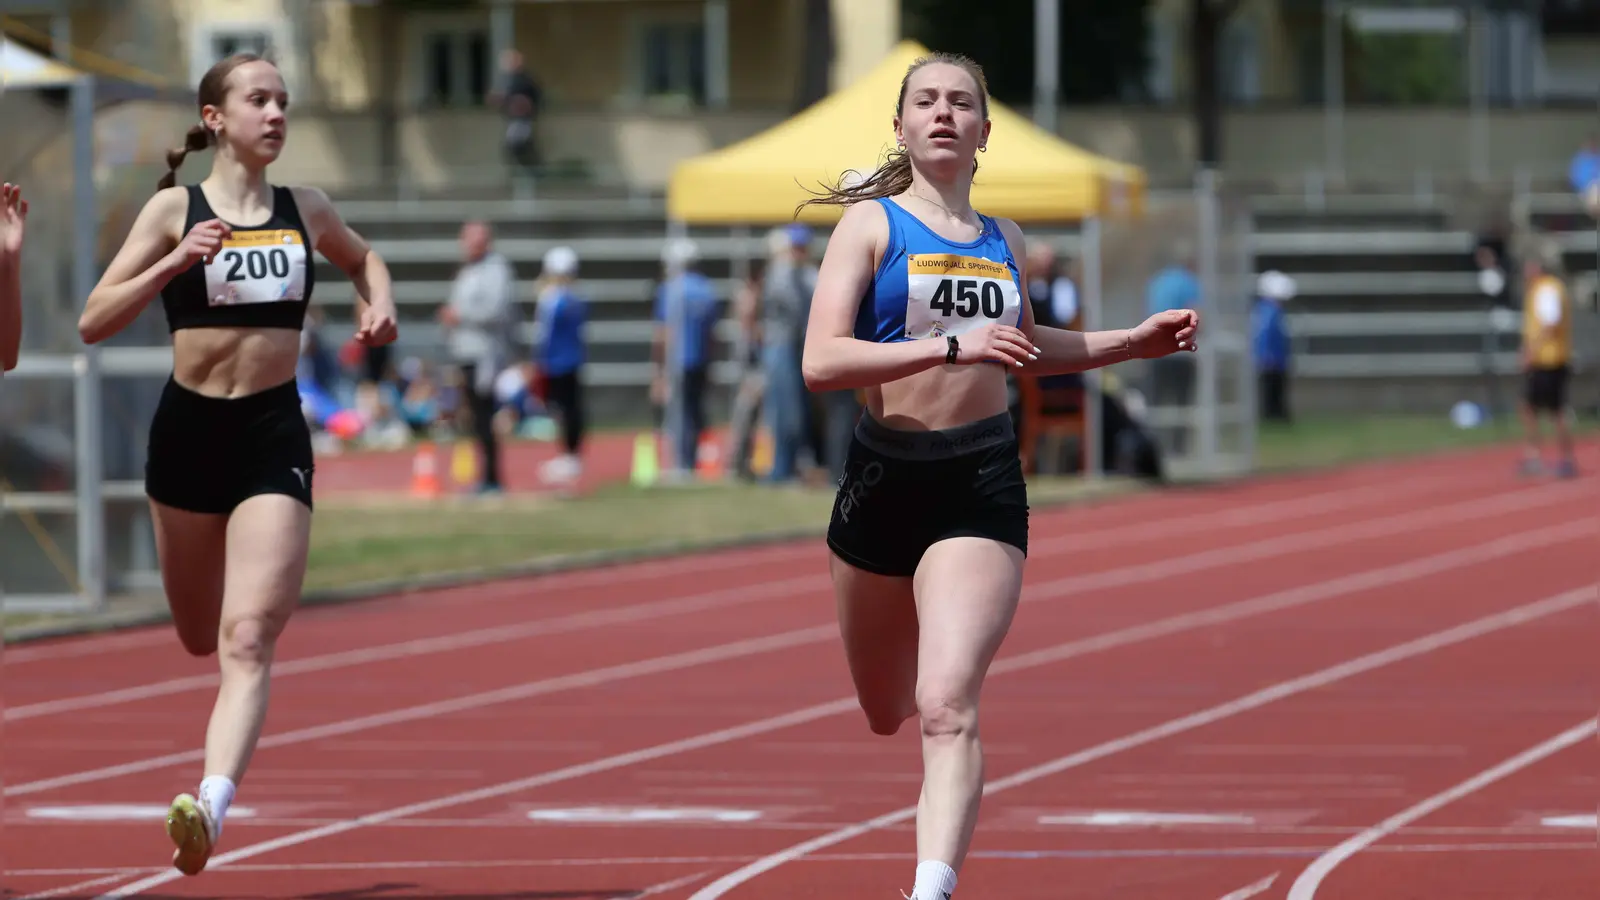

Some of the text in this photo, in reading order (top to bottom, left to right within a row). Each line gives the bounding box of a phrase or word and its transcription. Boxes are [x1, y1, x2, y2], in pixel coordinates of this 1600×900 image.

[224, 248, 289, 282] 200
[917, 260, 1003, 274] LUDWIG JALL SPORTFEST
[929, 279, 1004, 319] 450
